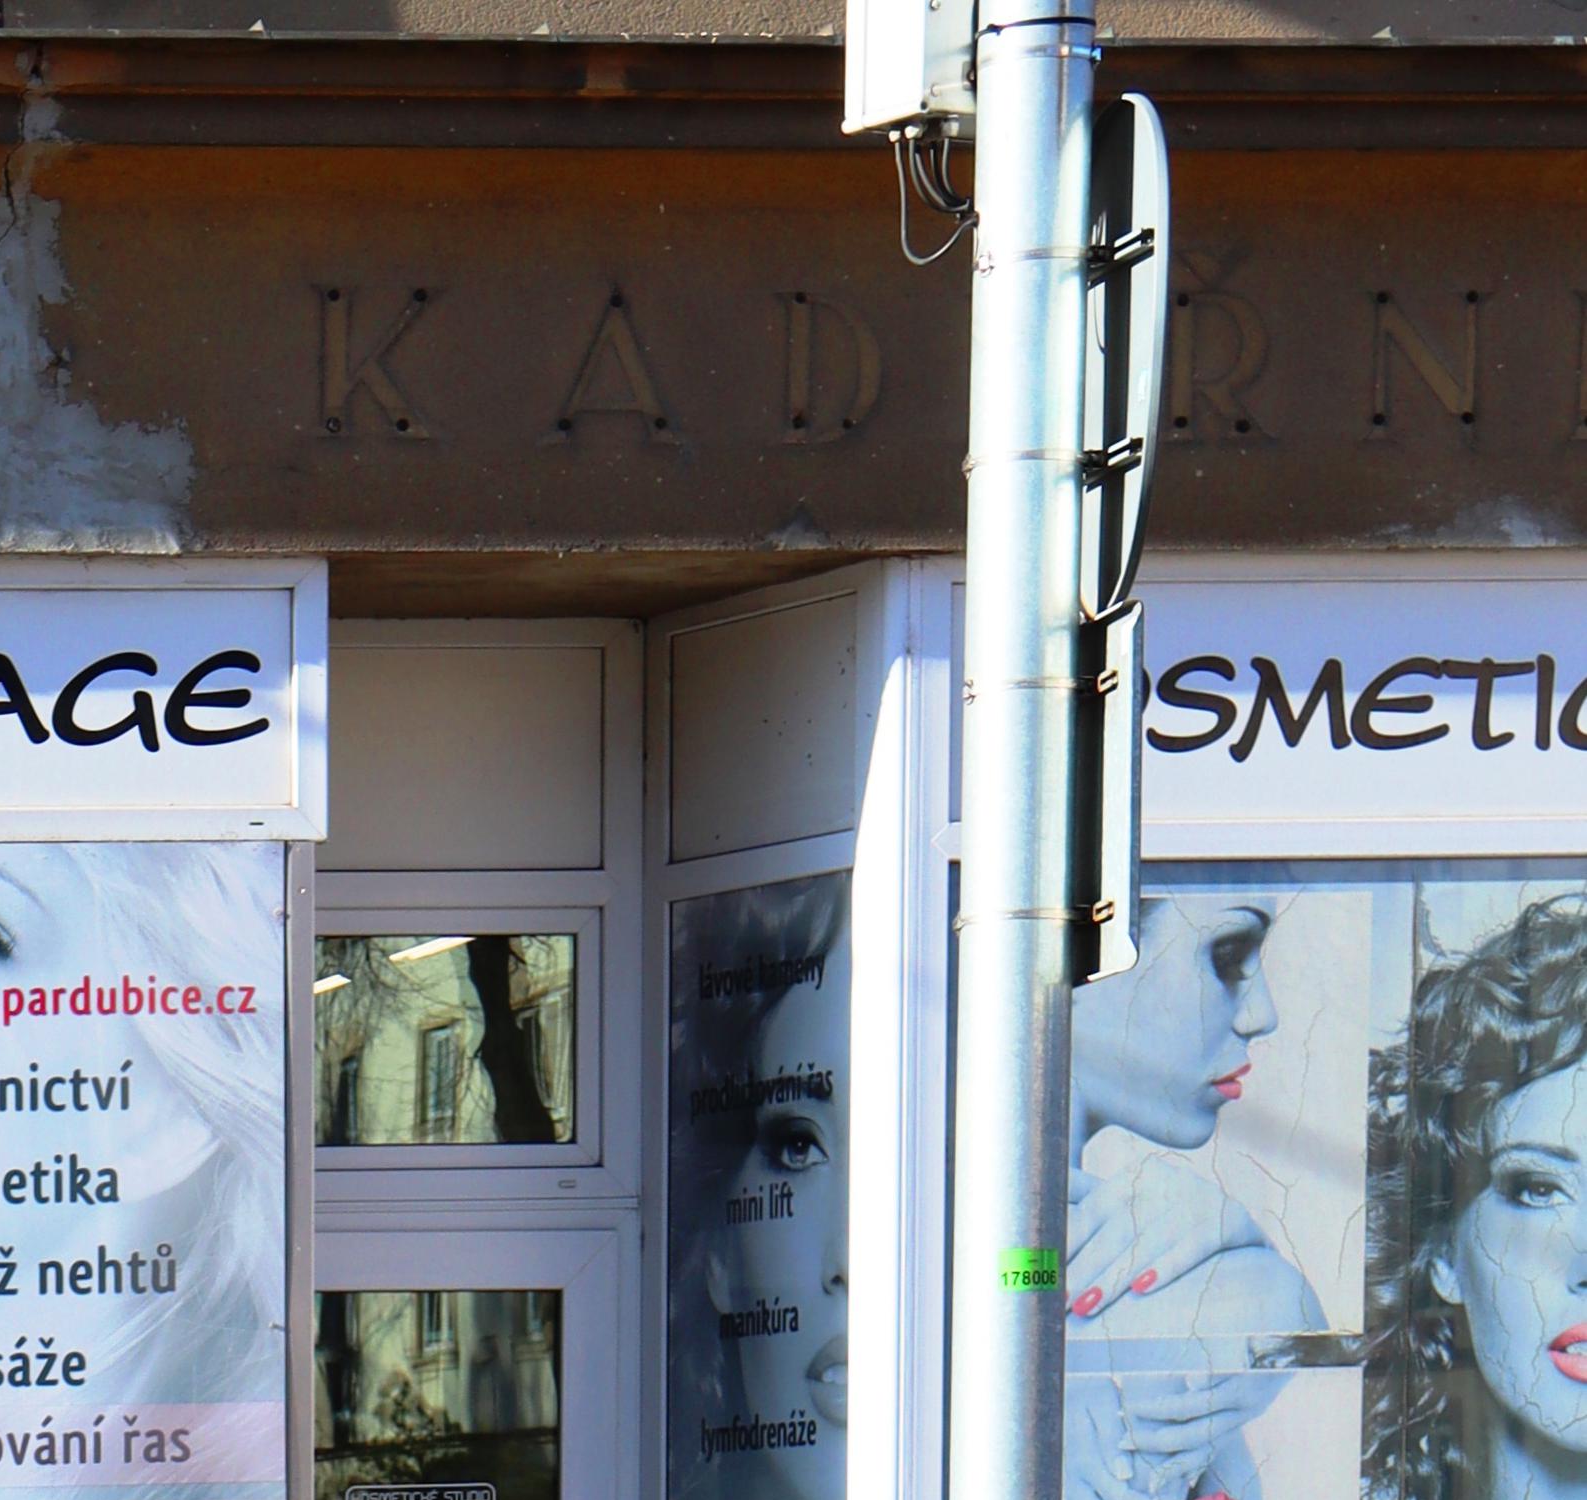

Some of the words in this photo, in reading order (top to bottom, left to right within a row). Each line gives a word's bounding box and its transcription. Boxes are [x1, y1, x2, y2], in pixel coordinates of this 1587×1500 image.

[726, 1186, 763, 1225] mini
[769, 1181, 794, 1219] lift
[38, 1244, 176, 1295] nehtů
[1001, 1270, 1057, 1286] 178006
[719, 1297, 799, 1340] manikúra
[123, 1417, 191, 1464] řas
[700, 1409, 816, 1463] lymfodrenáže
